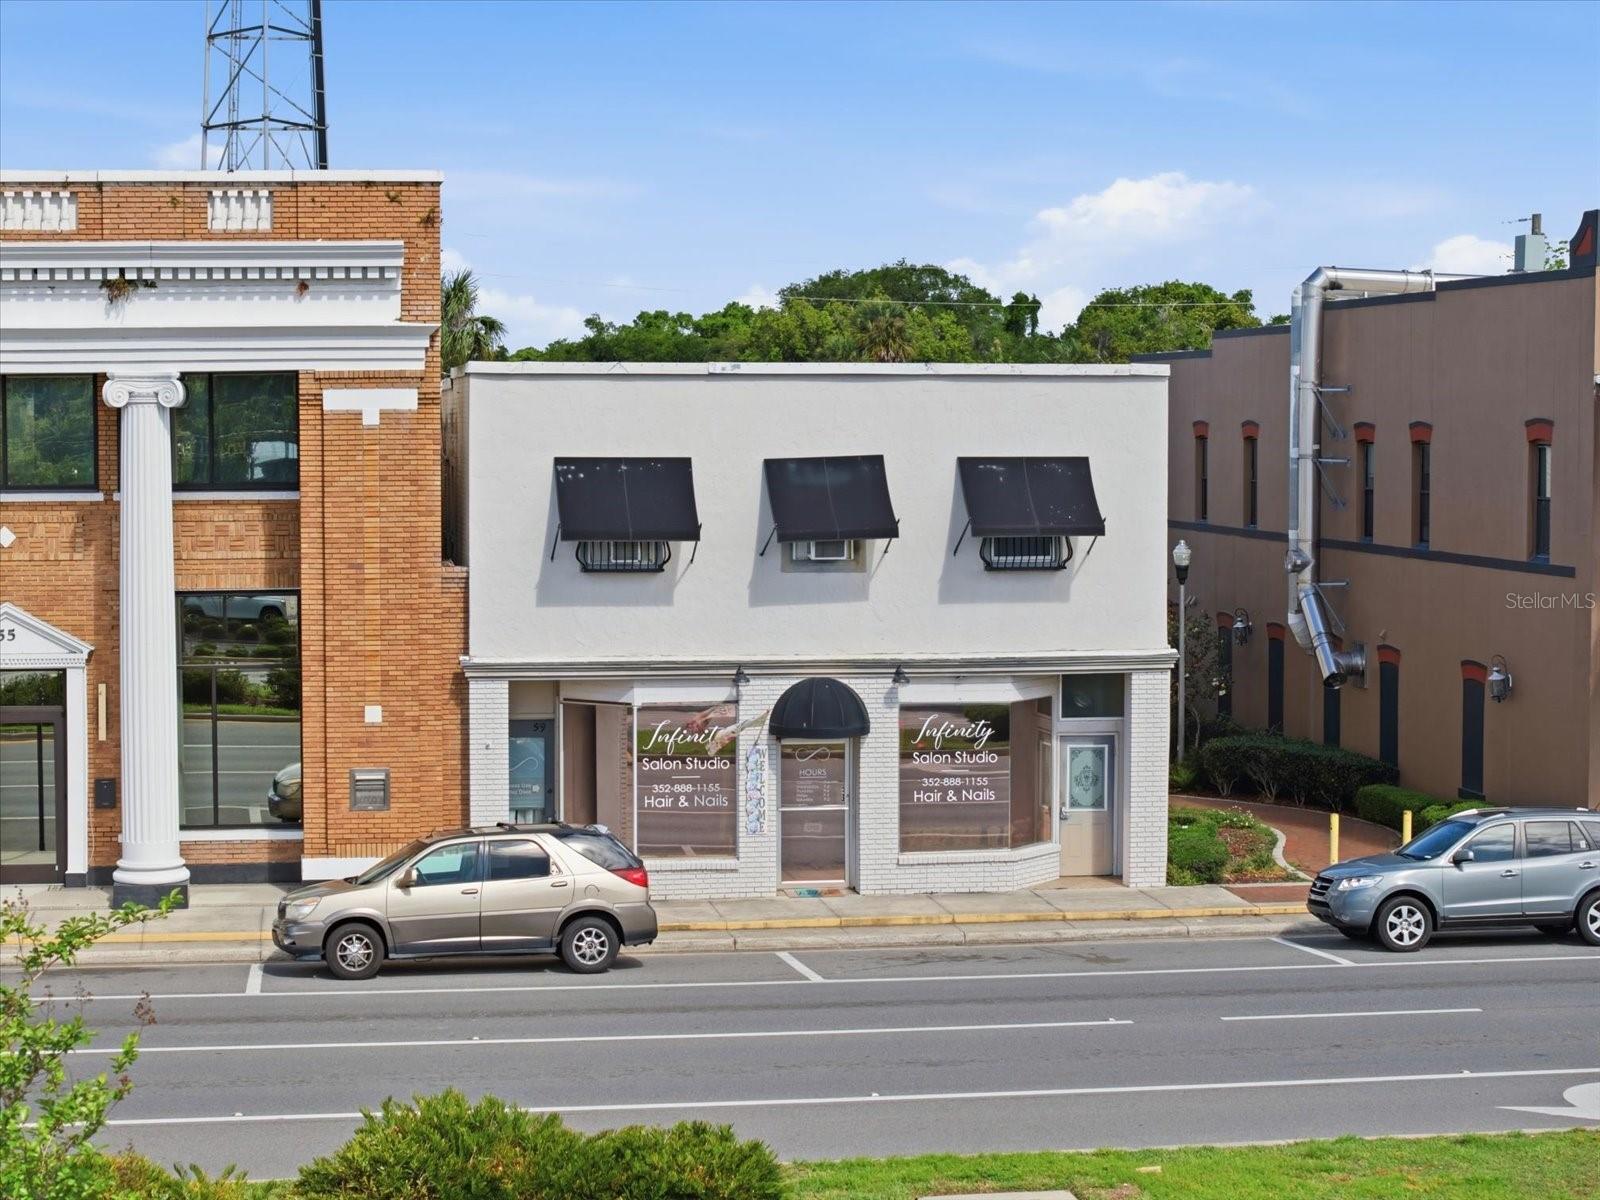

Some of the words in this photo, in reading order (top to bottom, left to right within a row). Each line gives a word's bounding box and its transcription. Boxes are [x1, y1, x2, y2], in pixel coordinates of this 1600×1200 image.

[642, 719, 719, 756] Infinit
[911, 713, 996, 750] Infinity
[642, 757, 682, 770] Salon
[685, 757, 730, 770] Studio
[912, 751, 951, 764] Salon
[954, 750, 998, 764] Studio
[799, 768, 828, 777] HOURS
[652, 783, 720, 793] 352-888-1155
[922, 777, 989, 787] 352-888-1155
[644, 795, 674, 808] Hair
[678, 795, 689, 807] &
[694, 794, 728, 807] Nails
[913, 789, 943, 802] Hair
[946, 789, 958, 802] &
[962, 788, 996, 801] Nails
